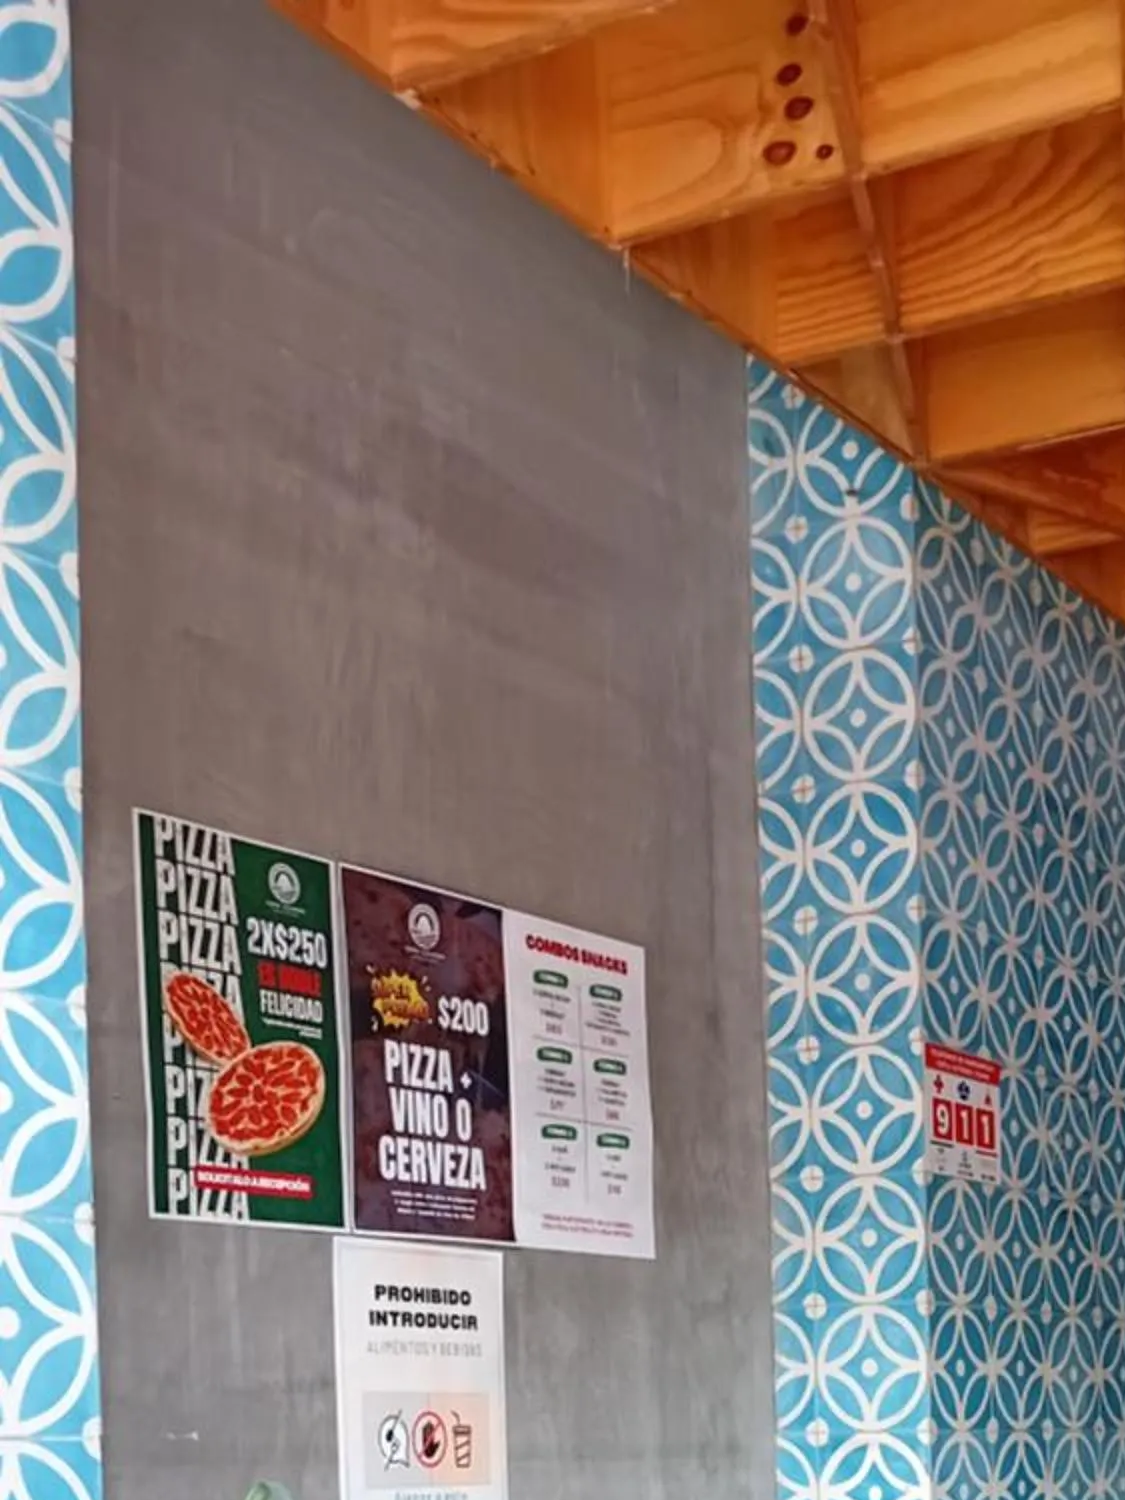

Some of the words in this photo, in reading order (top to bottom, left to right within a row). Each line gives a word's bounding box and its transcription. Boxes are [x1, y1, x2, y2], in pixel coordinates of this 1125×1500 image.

[153, 815, 236, 876] PIZZA
[155, 858, 239, 926] PIZZA
[158, 909, 243, 976] PIZZA
[259, 988, 323, 1024] FELICIDAD
[437, 995, 489, 1036] $200
[383, 1038, 454, 1094] PIZZA
[388, 1086, 449, 1139] VINO
[455, 1097, 472, 1142] O
[935, 1103, 991, 1146] 911
[378, 1133, 487, 1191] CERVEZA
[368, 1309, 479, 1331] INTRODUCIR
[374, 1284, 472, 1306] PROHIBIDO
